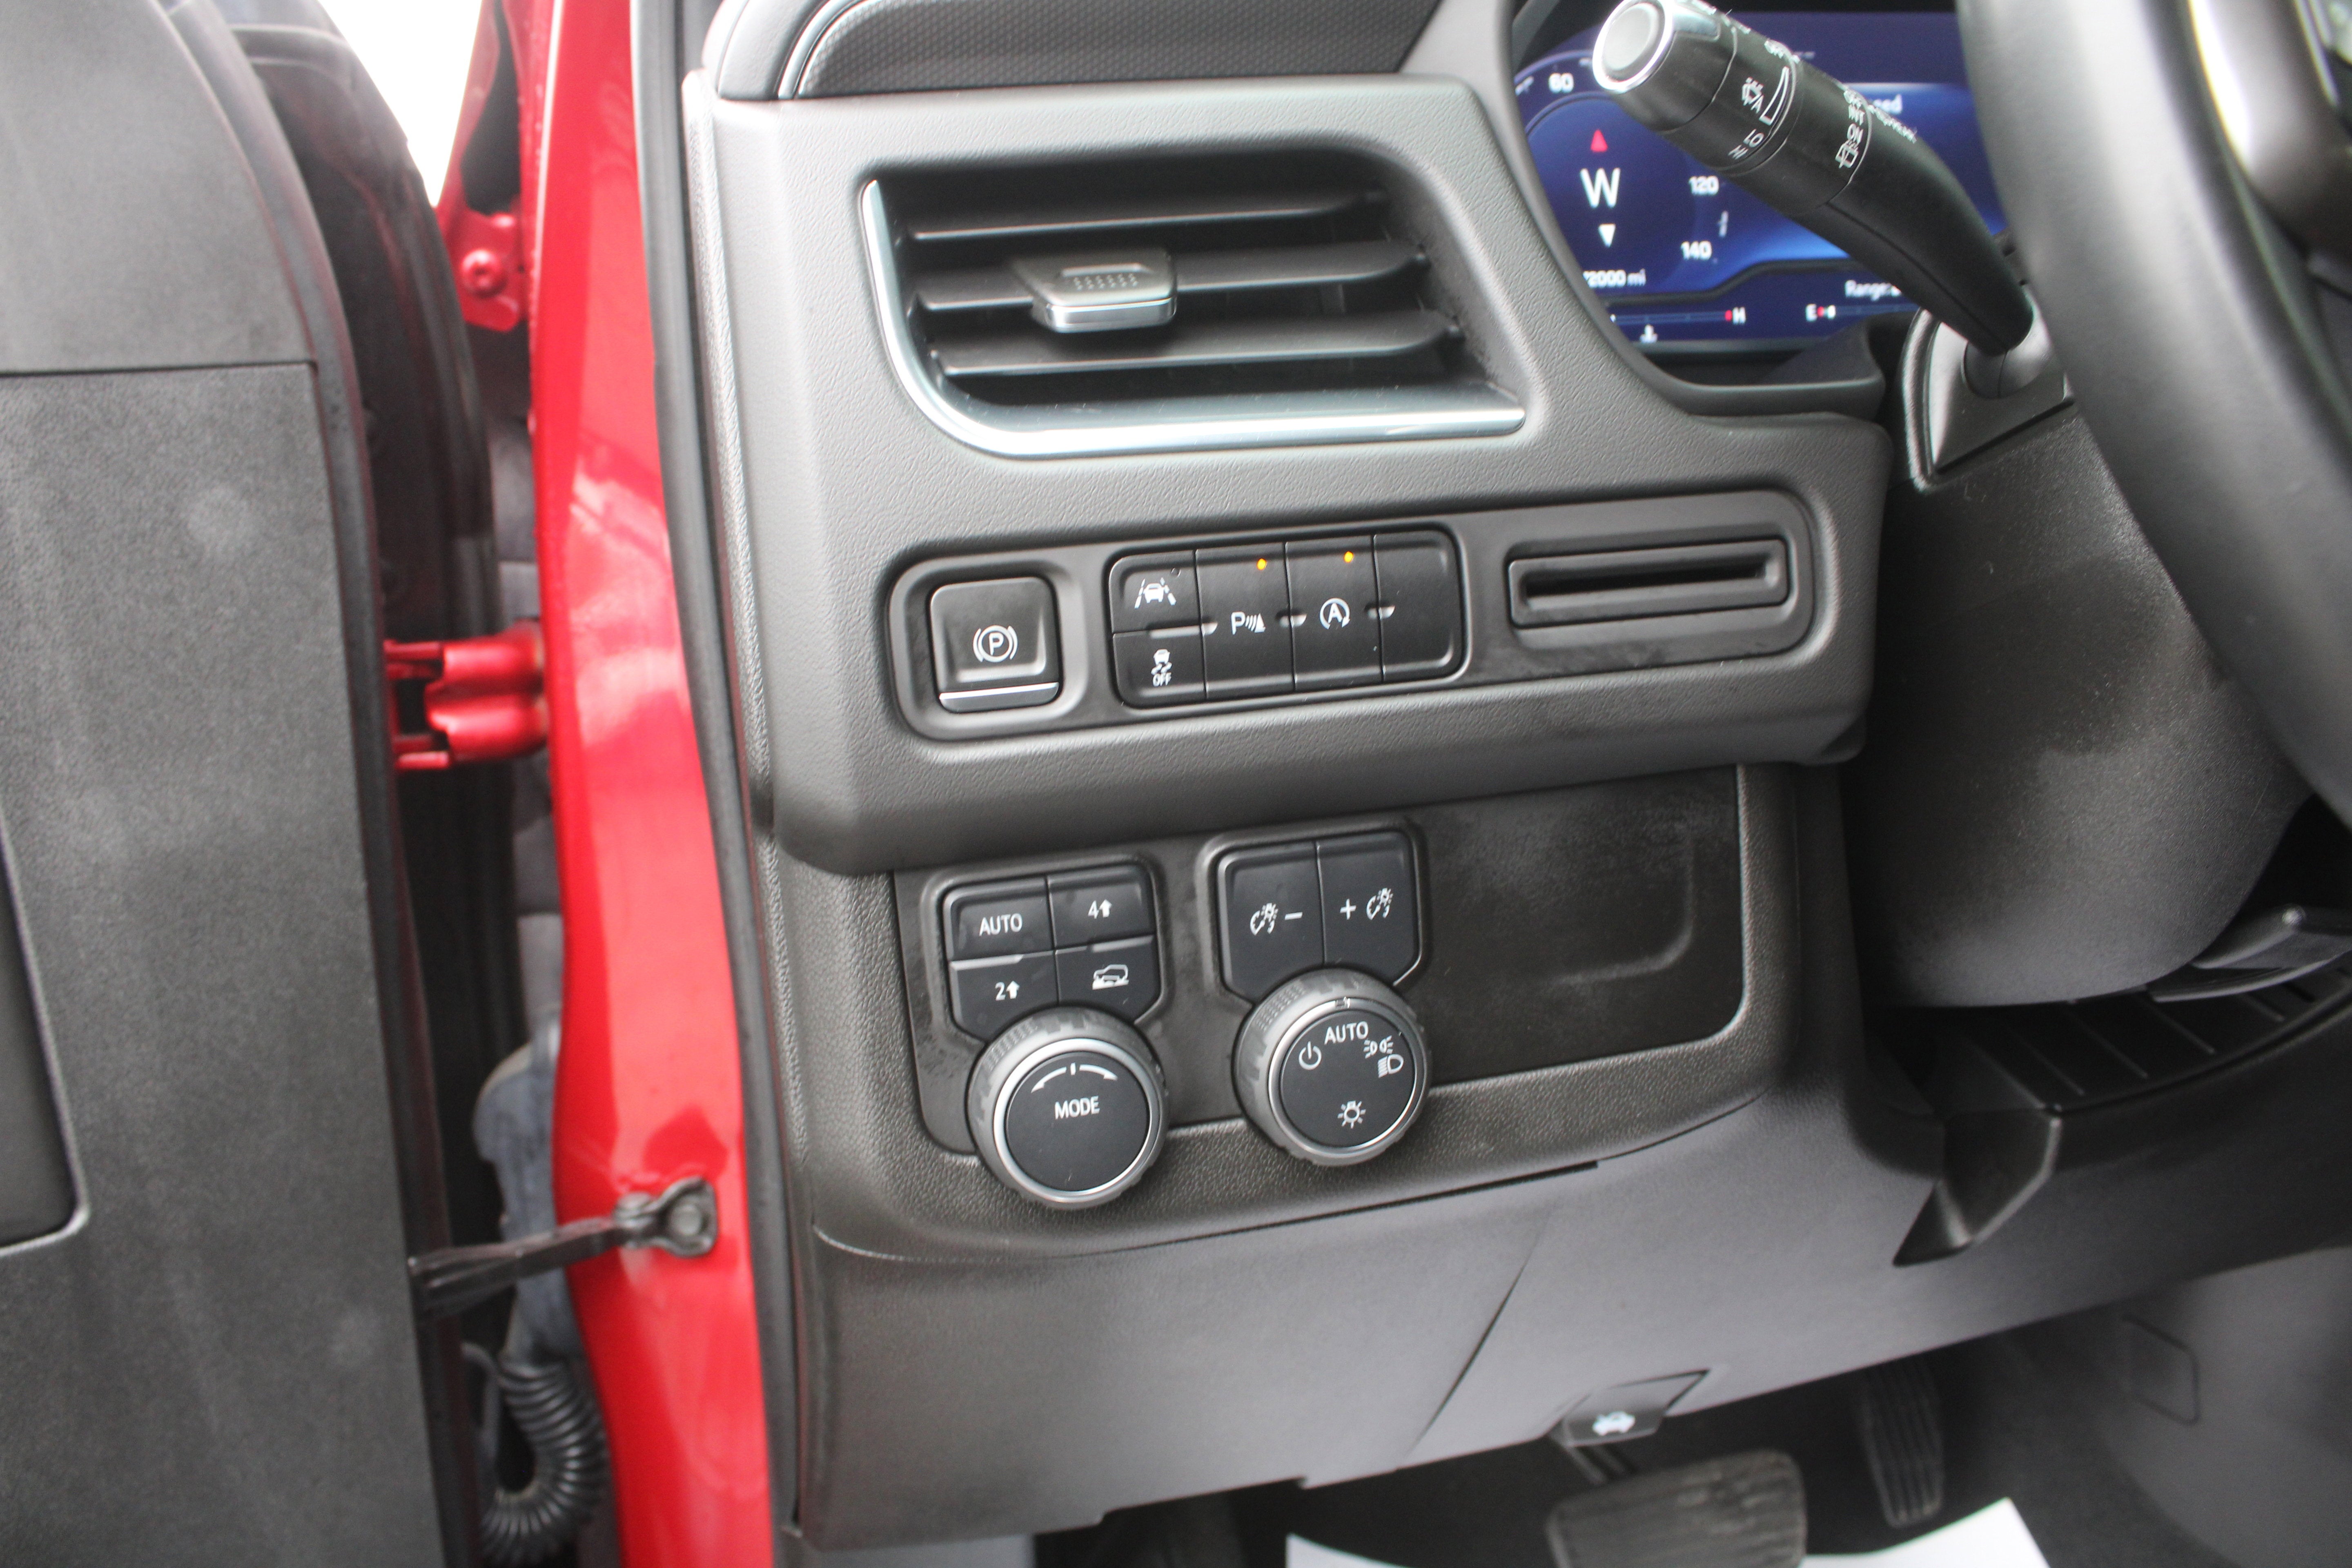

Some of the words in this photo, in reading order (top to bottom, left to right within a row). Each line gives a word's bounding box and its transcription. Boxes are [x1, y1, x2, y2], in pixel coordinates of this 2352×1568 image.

[1548, 72, 1574, 94] 60
[1743, 129, 1764, 147] LO
[1847, 123, 1864, 144] ON
[1580, 167, 1621, 208] W
[1688, 175, 1719, 196] 120
[1681, 241, 1712, 260] 140
[1732, 306, 1746, 325] H
[1805, 303, 1817, 322] E
[1231, 611, 1245, 635] P
[1328, 602, 1342, 623] A
[989, 632, 1004, 656] P
[1152, 672, 1172, 687] OFF
[1088, 900, 1099, 918] 4
[979, 913, 1022, 936] AUTO
[995, 982, 1006, 1001] 2
[1324, 1021, 1369, 1045] AUTO
[1055, 1095, 1100, 1120] MODE
